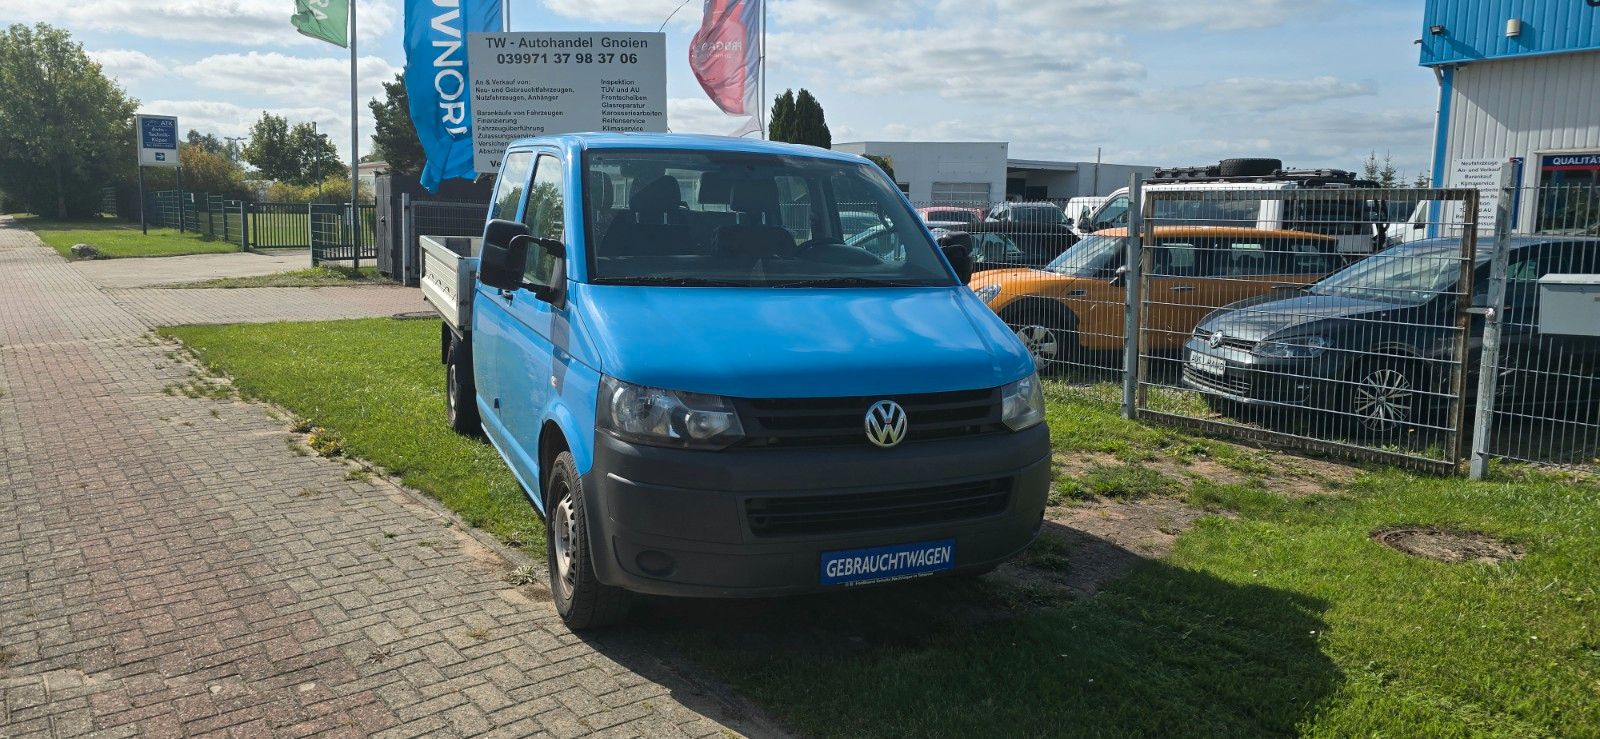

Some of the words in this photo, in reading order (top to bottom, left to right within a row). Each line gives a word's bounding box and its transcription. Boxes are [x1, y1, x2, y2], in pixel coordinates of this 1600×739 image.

[486, 37, 506, 48] TW
[518, 37, 593, 48] Autohandel
[600, 37, 648, 48] Gnoien
[497, 53, 548, 64] 039971
[554, 53, 570, 64] 37
[576, 53, 593, 64] 98
[598, 53, 615, 64] 37
[620, 53, 638, 64] 06
[826, 546, 952, 578] GEBRAUCHTWAGEN
